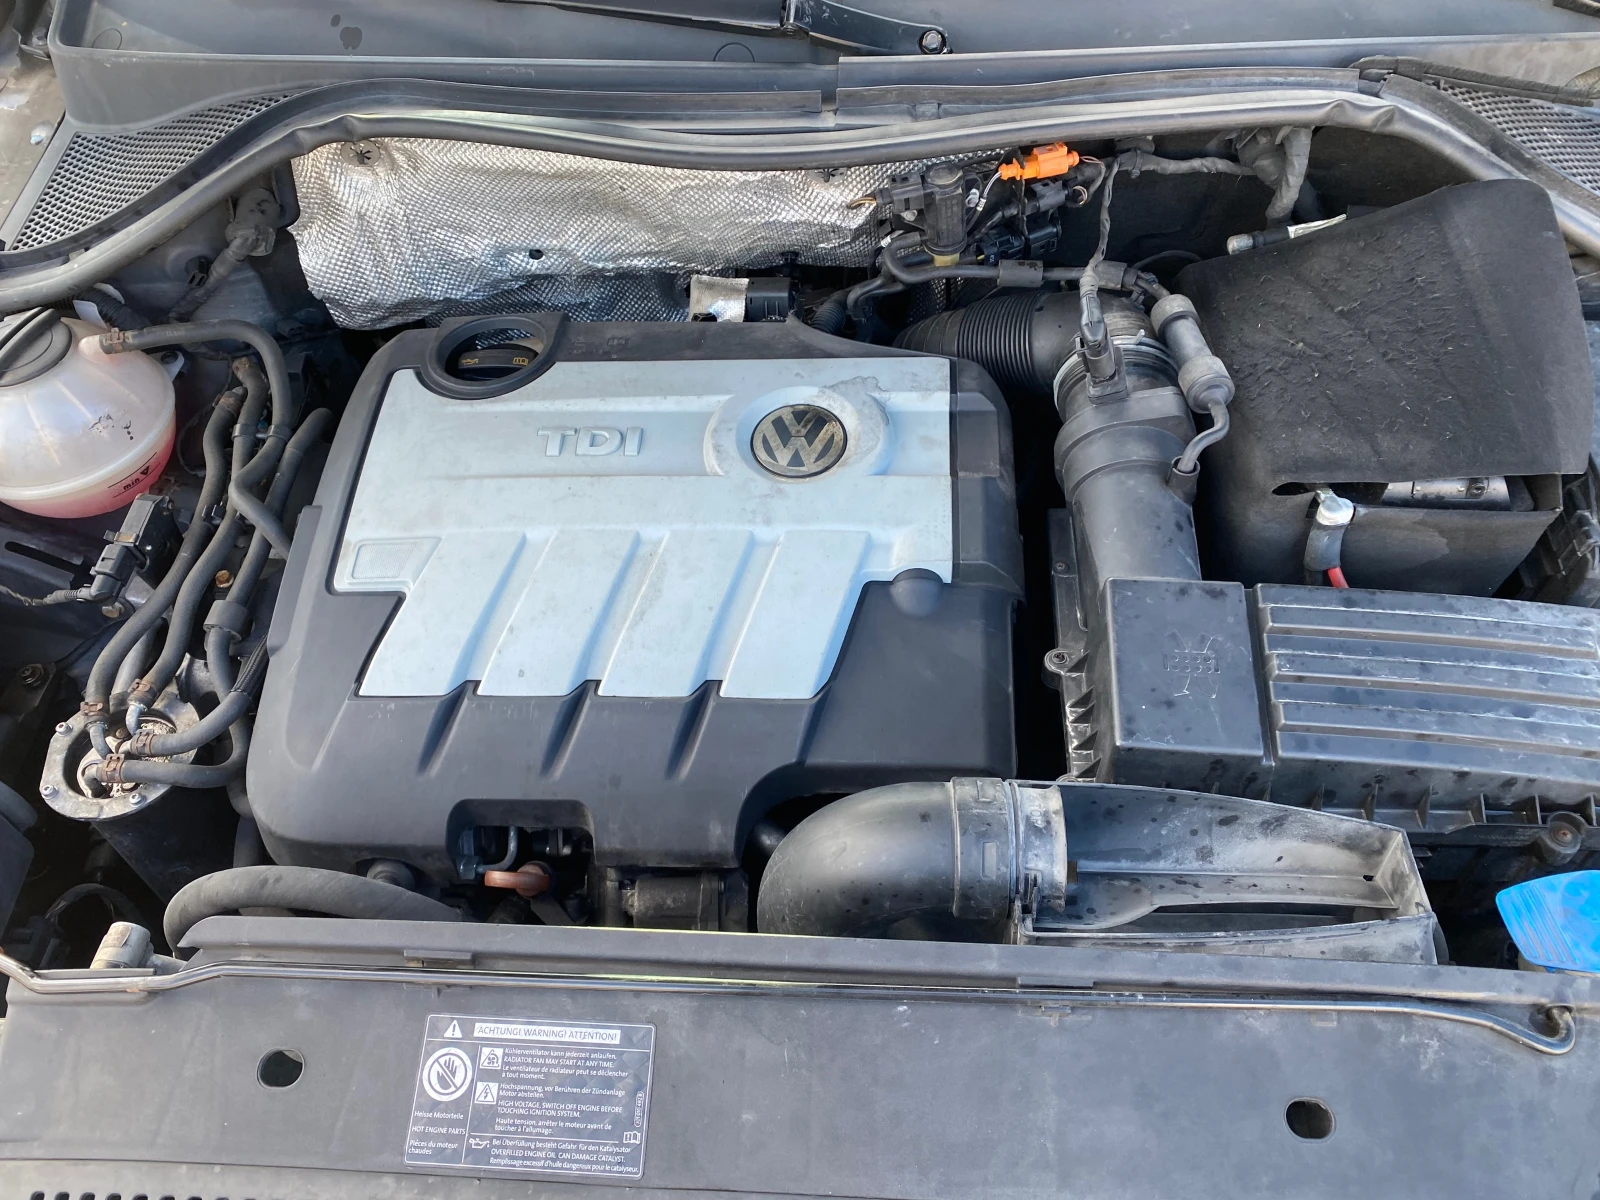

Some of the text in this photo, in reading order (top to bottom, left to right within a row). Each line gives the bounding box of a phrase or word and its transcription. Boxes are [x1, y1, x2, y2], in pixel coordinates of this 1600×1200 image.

[537, 426, 644, 457] TDI
[123, 478, 140, 490] min
[478, 1026, 617, 1040] ACHTUNG! WARNING! ATTENTION!
[505, 1047, 550, 1056] Kühlerventilator
[590, 1052, 617, 1060] anlaufen.
[504, 1056, 532, 1064] RADIATOR
[598, 1069, 629, 1077] déclencher
[554, 1085, 580, 1093] Berühren
[592, 1087, 626, 1097] Zündanlage
[434, 1112, 464, 1120] Motorteile
[557, 1110, 581, 1118] SYSTEM.
[425, 1126, 447, 1134] ENGINE
[491, 1148, 523, 1157] OVERFILLED
[598, 1154, 626, 1162] CATALYST.
[600, 1146, 631, 1154] Katalysator
[490, 1157, 523, 1166] Remplissage
[563, 1163, 591, 1171] dangereux
